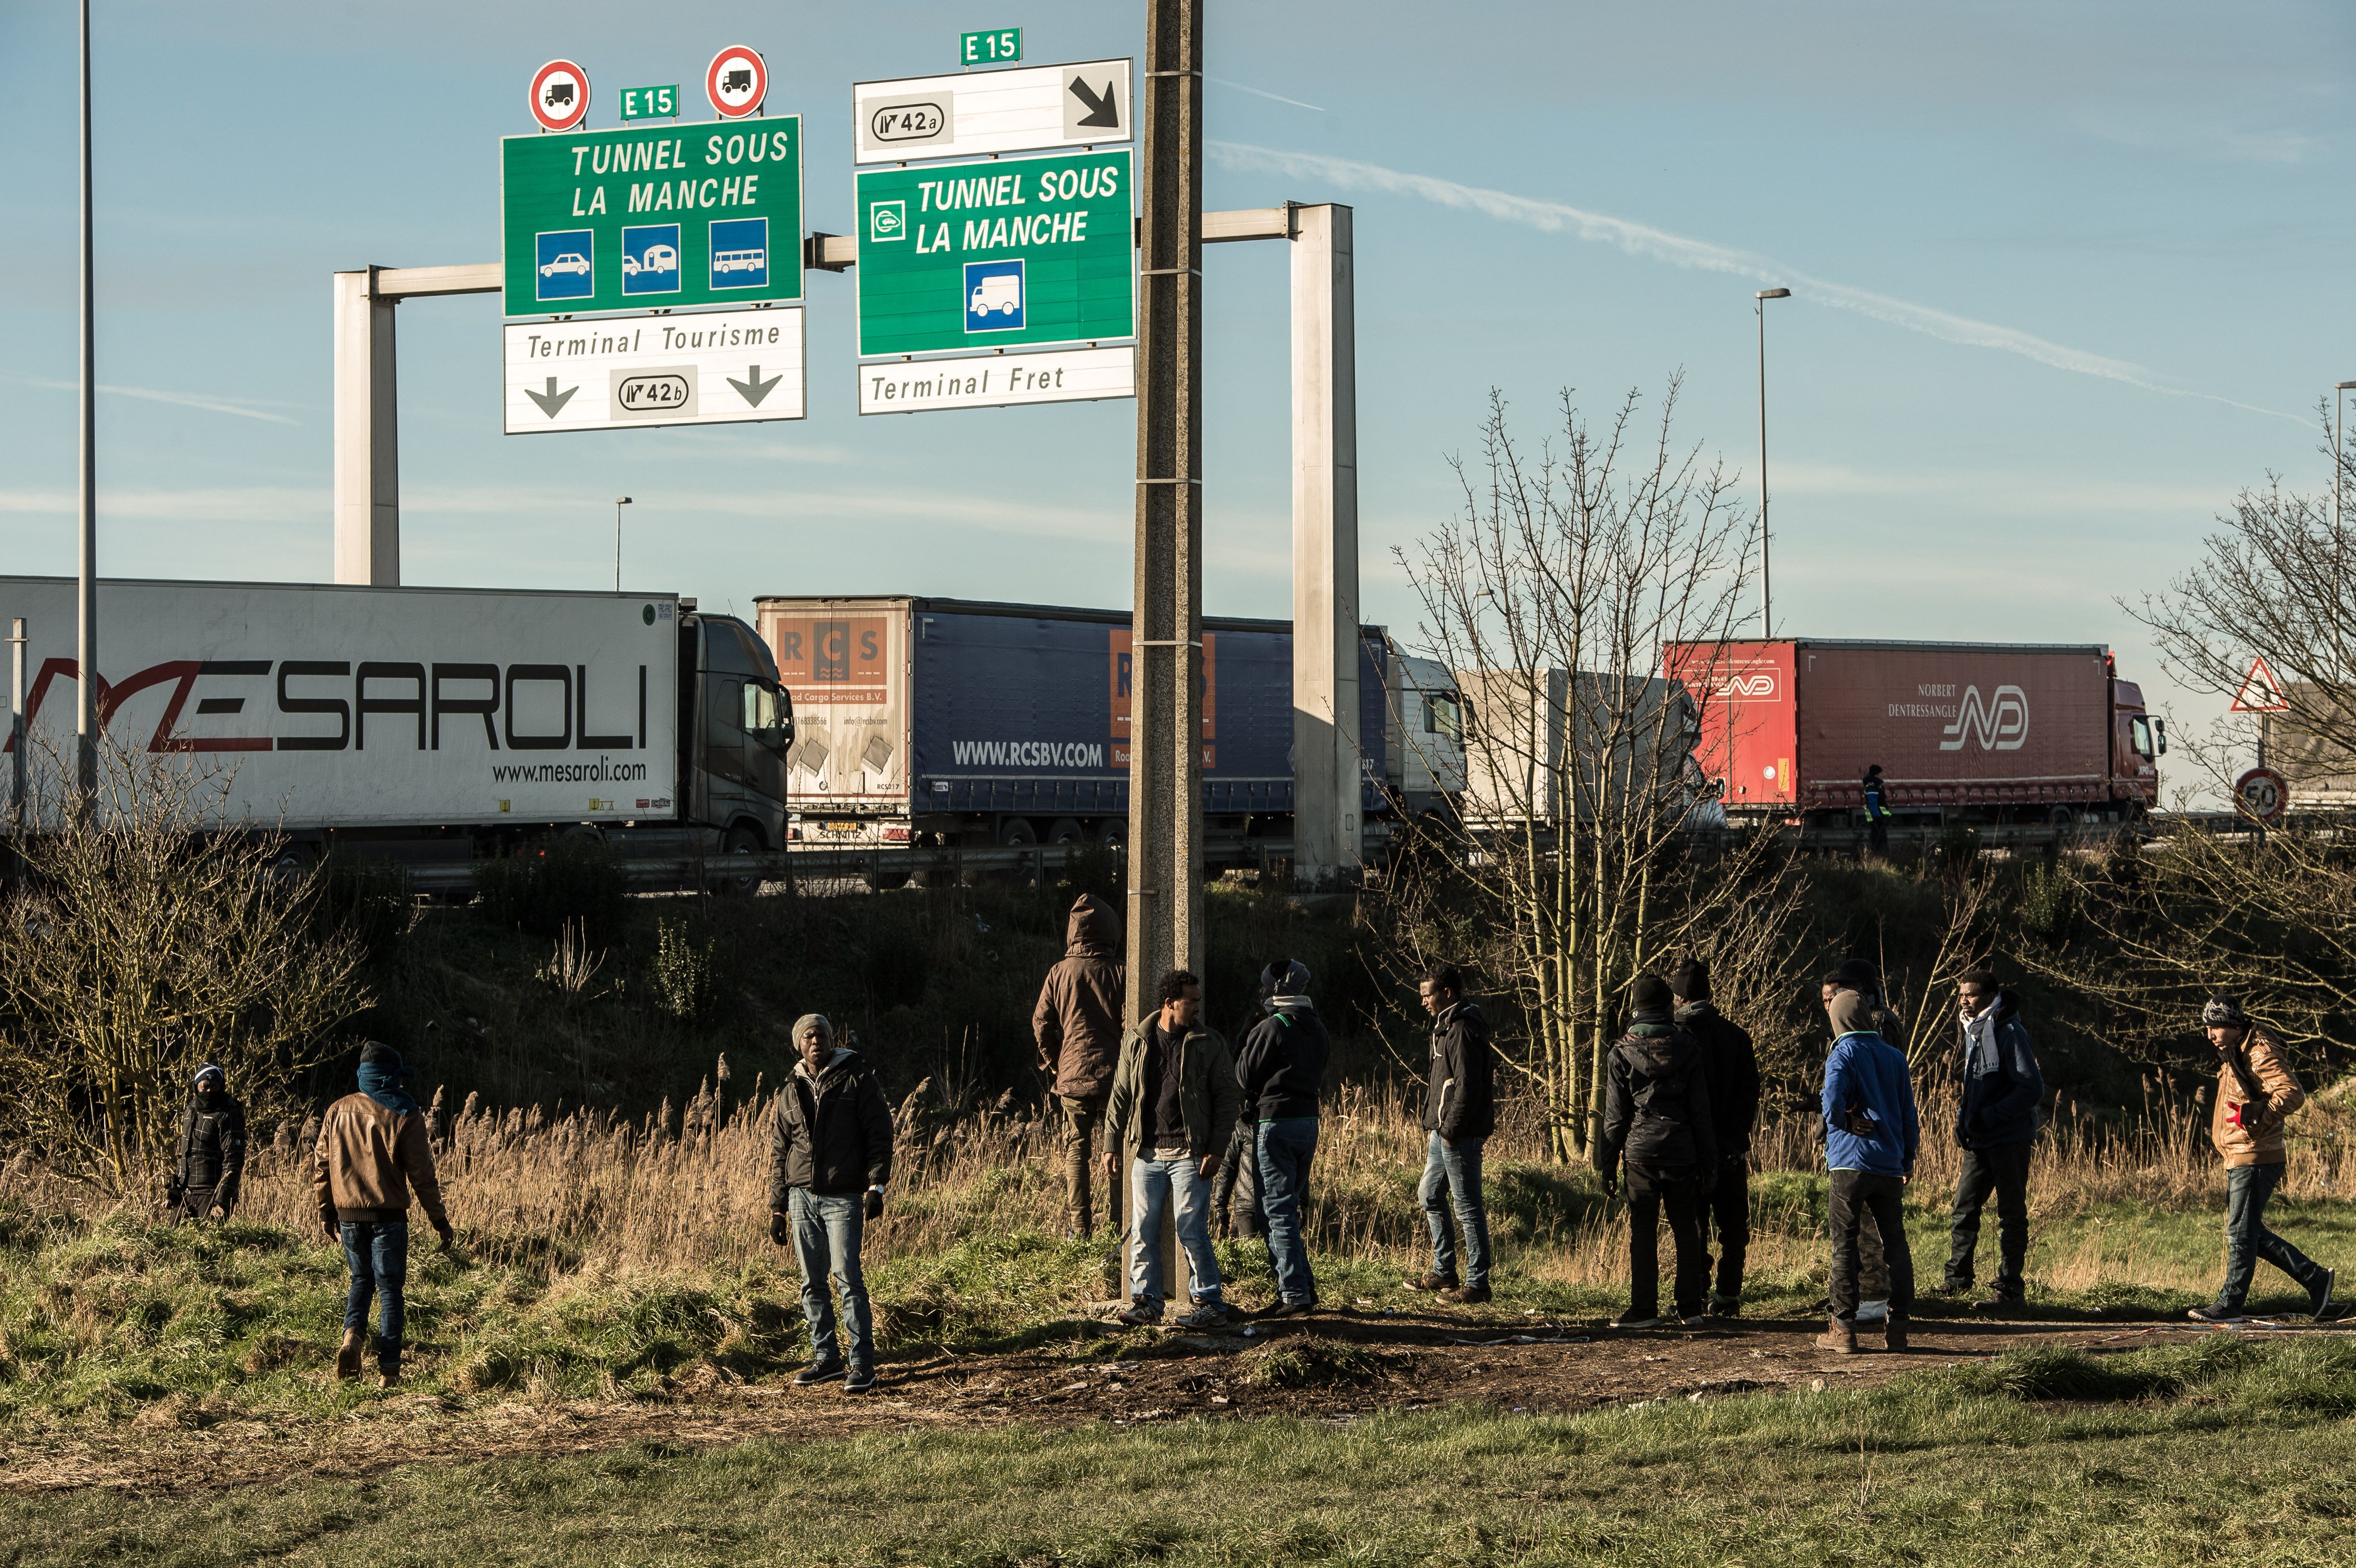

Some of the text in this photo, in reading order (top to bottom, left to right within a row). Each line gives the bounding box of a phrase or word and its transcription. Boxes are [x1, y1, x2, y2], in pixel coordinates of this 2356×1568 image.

[967, 33, 1015, 60] E 15
[626, 89, 671, 115] E 15
[901, 112, 937, 132] 42a
[572, 132, 788, 175] TUNNEL SOUS
[572, 175, 759, 216] LA MANCHE
[918, 166, 1119, 212] TUNNEL SOUS
[916, 211, 1088, 254] LA MANCHE
[528, 323, 780, 358] Terminal Tourisme
[646, 383, 682, 402] 42b
[872, 367, 1064, 401] Terminal Fret
[783, 631, 878, 661] RCS
[804, 693, 829, 703] Cargo
[831, 692, 864, 701] Services
[866, 692, 882, 701] B.V.
[1918, 684, 1956, 697] NORBERT
[2, 658, 647, 753] MESAROLI
[1888, 704, 1957, 718] DENTRESSANGLE
[844, 716, 888, 726] info@rcsbv.com
[953, 741, 1103, 768] WWW.RCSBV.COM
[493, 755, 647, 784] www.mesaroli.com
[2246, 784, 2276, 808] 50
